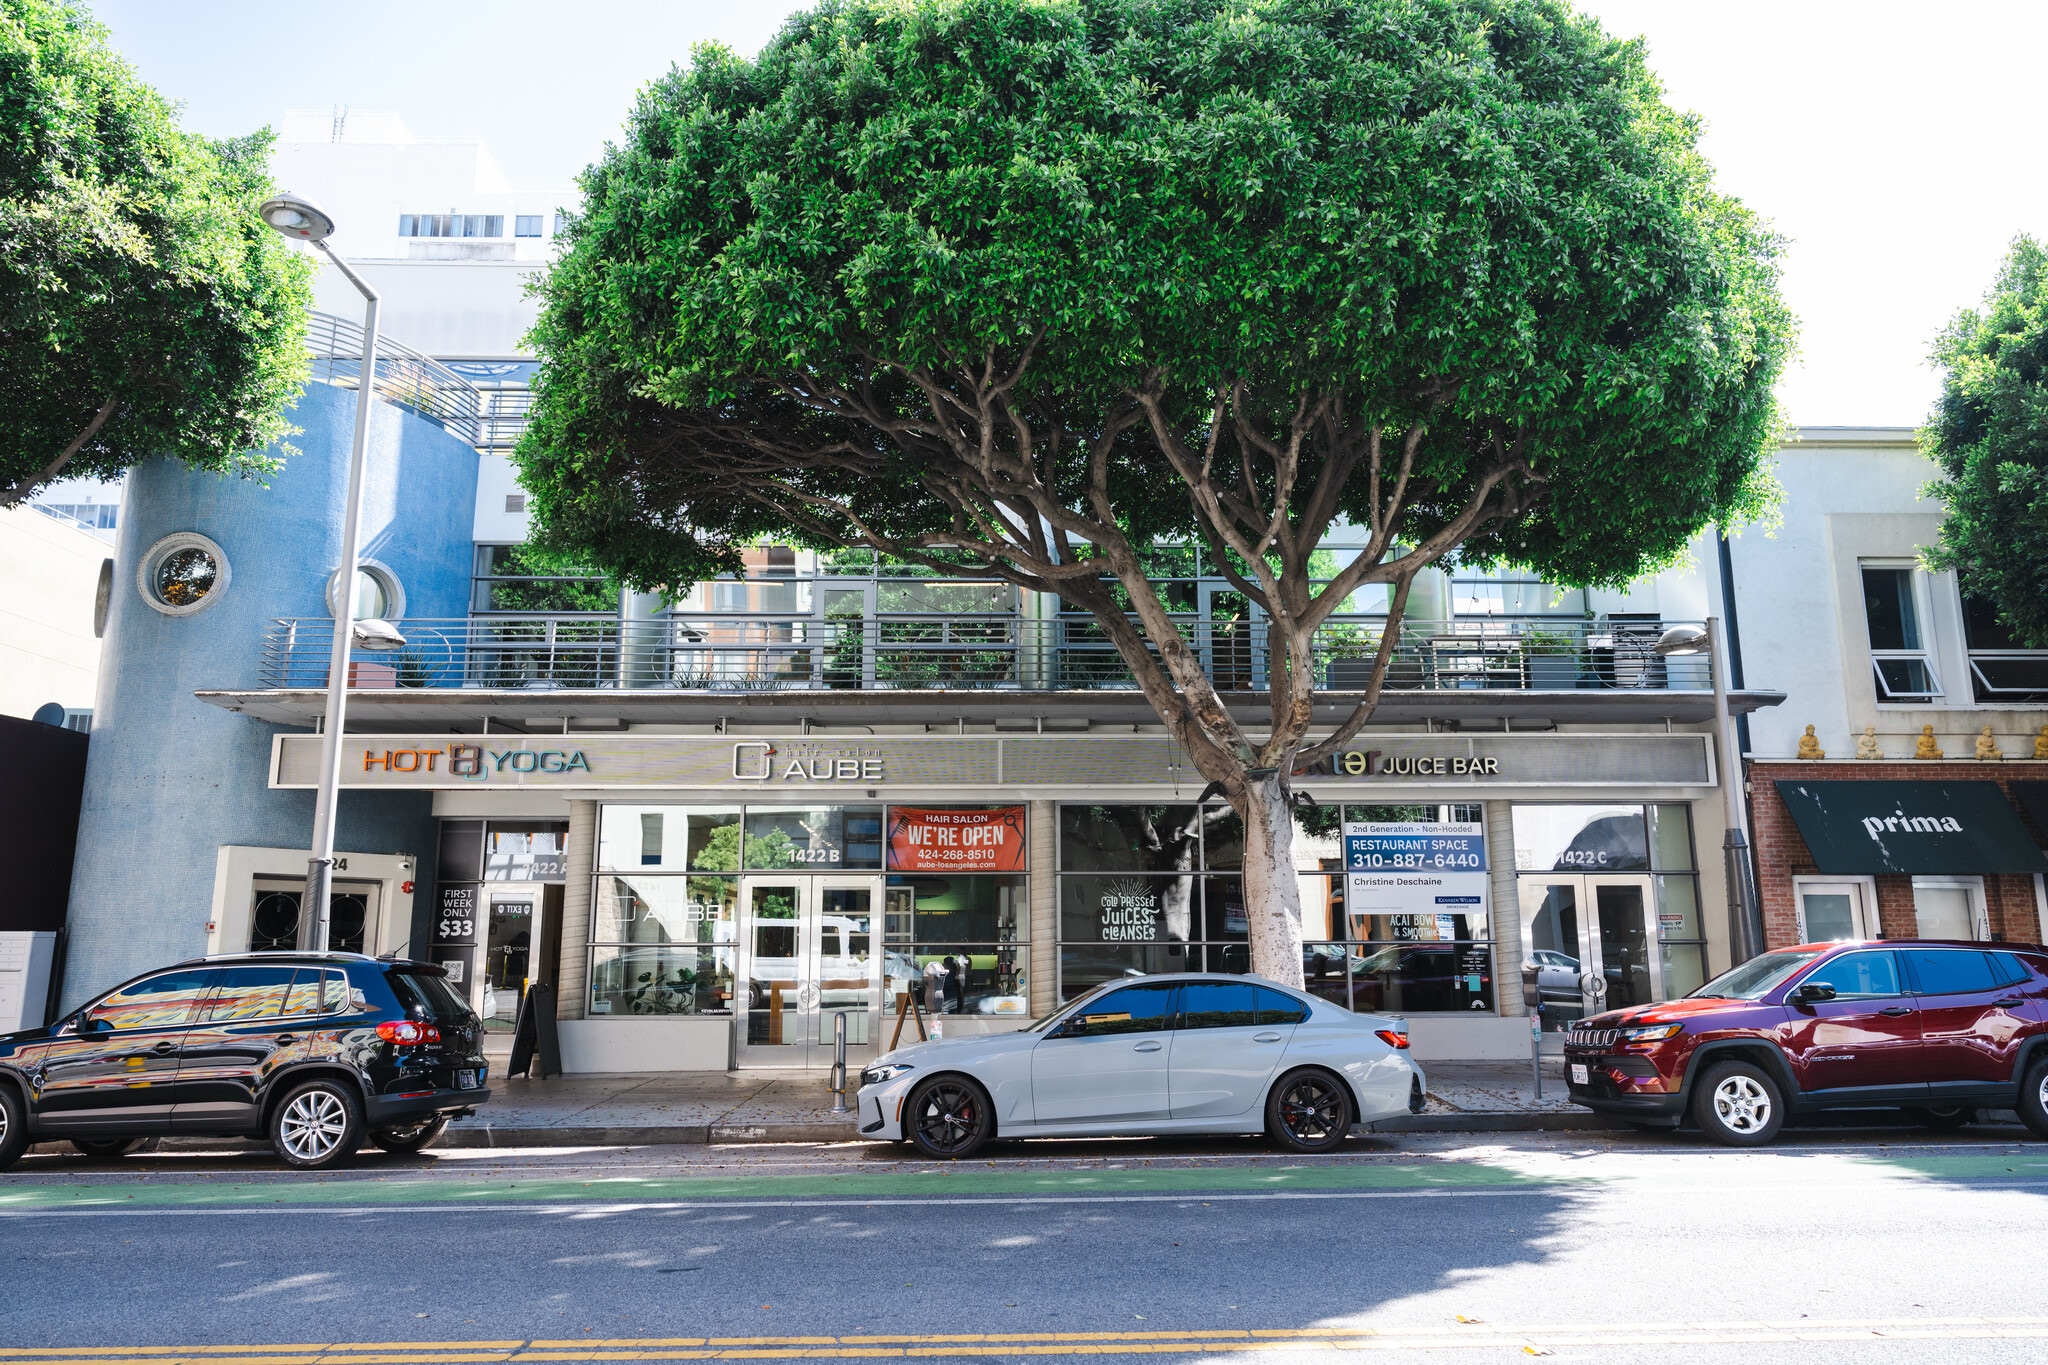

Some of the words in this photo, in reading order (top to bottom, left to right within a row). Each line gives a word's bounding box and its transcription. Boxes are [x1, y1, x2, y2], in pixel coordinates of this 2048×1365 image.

[836, 746, 881, 756] salon
[363, 750, 443, 772] HOT
[488, 750, 589, 773] YOGA
[1383, 757, 1446, 774] JUICE
[1453, 757, 1499, 774] BAR
[783, 759, 884, 779] AUBE
[926, 815, 950, 823] HAIR
[953, 815, 988, 823] SALON
[1352, 825, 1368, 833] 2nd
[1370, 825, 1414, 833] Generation
[1422, 825, 1473, 833] Non-Hooded
[1861, 810, 1964, 841] prima
[908, 825, 958, 846] WE'RE
[962, 825, 1004, 846] OPEN
[1352, 839, 1428, 850] RESTAURANT
[1431, 839, 1469, 850] SPACE
[788, 849, 828, 862] 1422
[829, 849, 840, 862] B
[917, 849, 995, 860] 424-268-8510
[1353, 853, 1479, 867] 310-887-6440
[1557, 851, 1595, 864] 1422
[1597, 851, 1608, 864] C
[522, 862, 558, 874] 1422
[916, 861, 996, 869] aube-losangeles.com
[1354, 878, 1394, 886] Christine
[1396, 878, 1443, 886] Deschaine
[444, 889, 473, 898] FIRST
[443, 899, 473, 908] WEEK
[443, 908, 472, 917] ONLY
[1390, 914, 1410, 926] ACAI
[439, 919, 473, 938] $33
[996, 1002, 1023, 1010] OPEN
